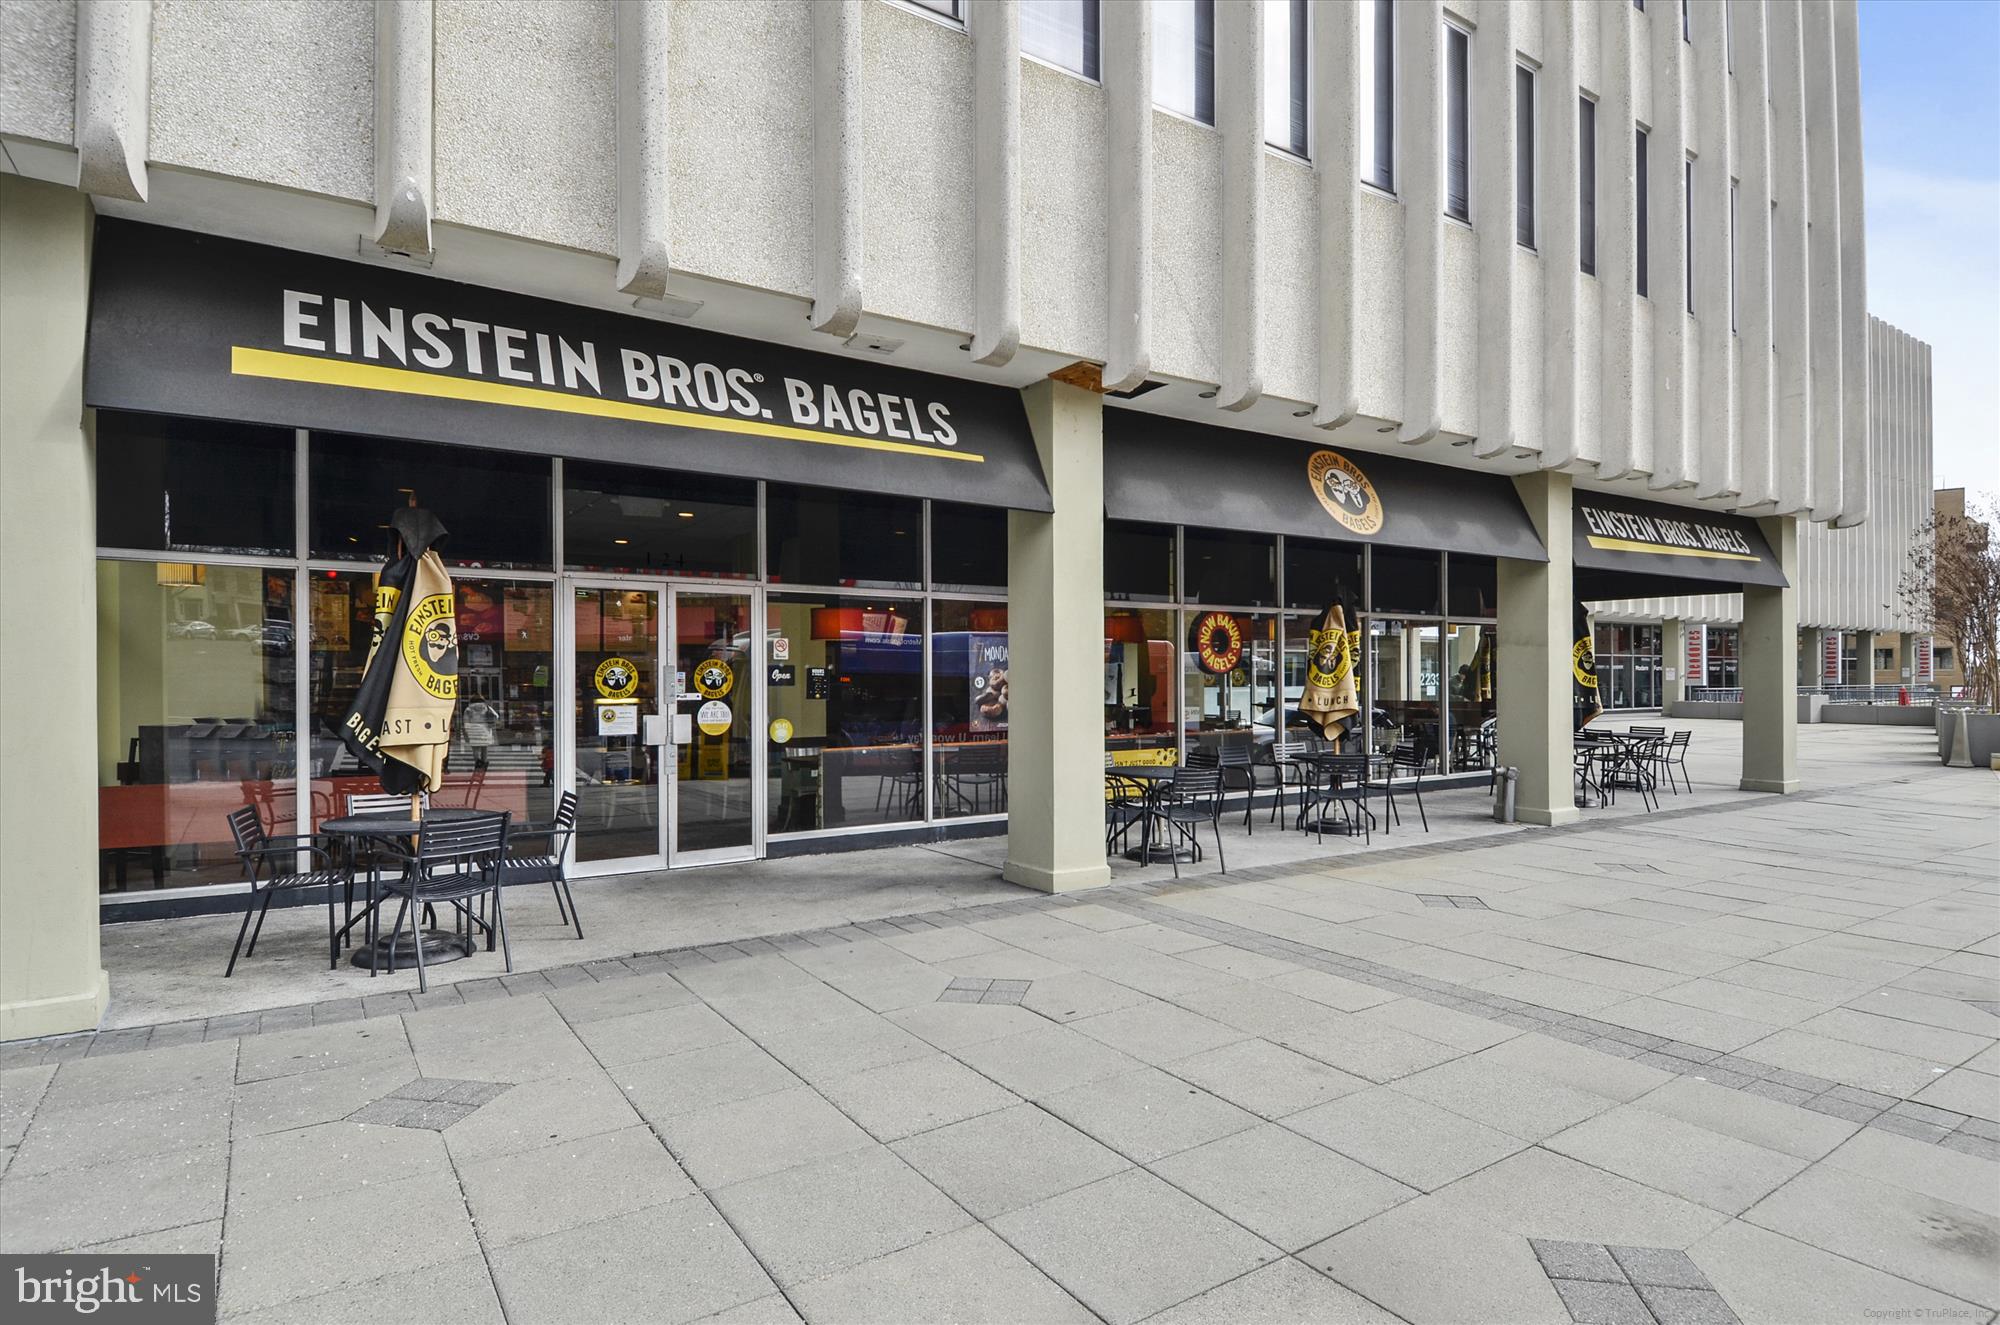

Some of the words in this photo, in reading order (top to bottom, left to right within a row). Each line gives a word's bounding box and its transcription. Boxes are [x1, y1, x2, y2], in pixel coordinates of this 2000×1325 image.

[283, 289, 602, 395] EINSTEIN
[784, 377, 958, 446] BAGELS
[1310, 453, 1341, 482] EINSTEIN
[1343, 461, 1370, 489] BROS
[1343, 513, 1377, 531] BAGELS
[1581, 506, 1662, 543] EINSTEIN
[1695, 524, 1751, 554] BAGELS
[1200, 615, 1217, 644] NOW
[1217, 613, 1241, 649] BAKING
[1202, 647, 1237, 670] BAGELS
[772, 669, 791, 681] Open
[1312, 674, 1339, 687] BAGELS
[1317, 695, 1349, 706] LUNCH
[346, 711, 387, 765] BAGE
